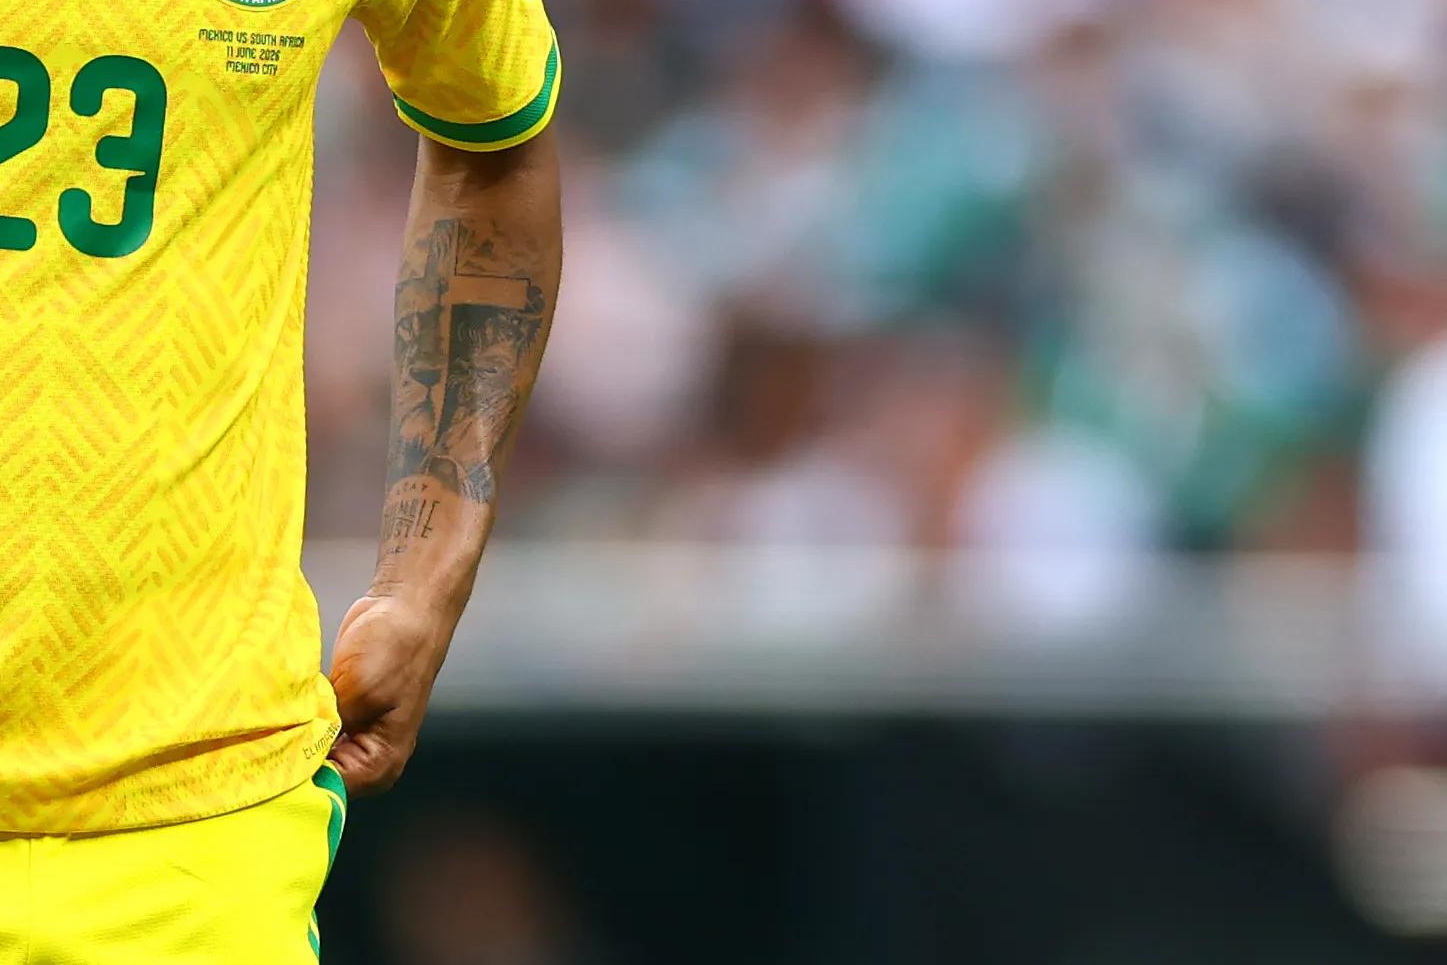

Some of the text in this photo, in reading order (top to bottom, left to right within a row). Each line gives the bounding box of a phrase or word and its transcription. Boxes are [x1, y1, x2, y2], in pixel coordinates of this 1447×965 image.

[198, 28, 234, 42] MEXICO
[250, 33, 277, 46] SOUTH
[279, 35, 305, 49] AFRICA
[226, 45, 281, 62] 11 JUNE 2026
[226, 60, 278, 76] MEXICO CITY
